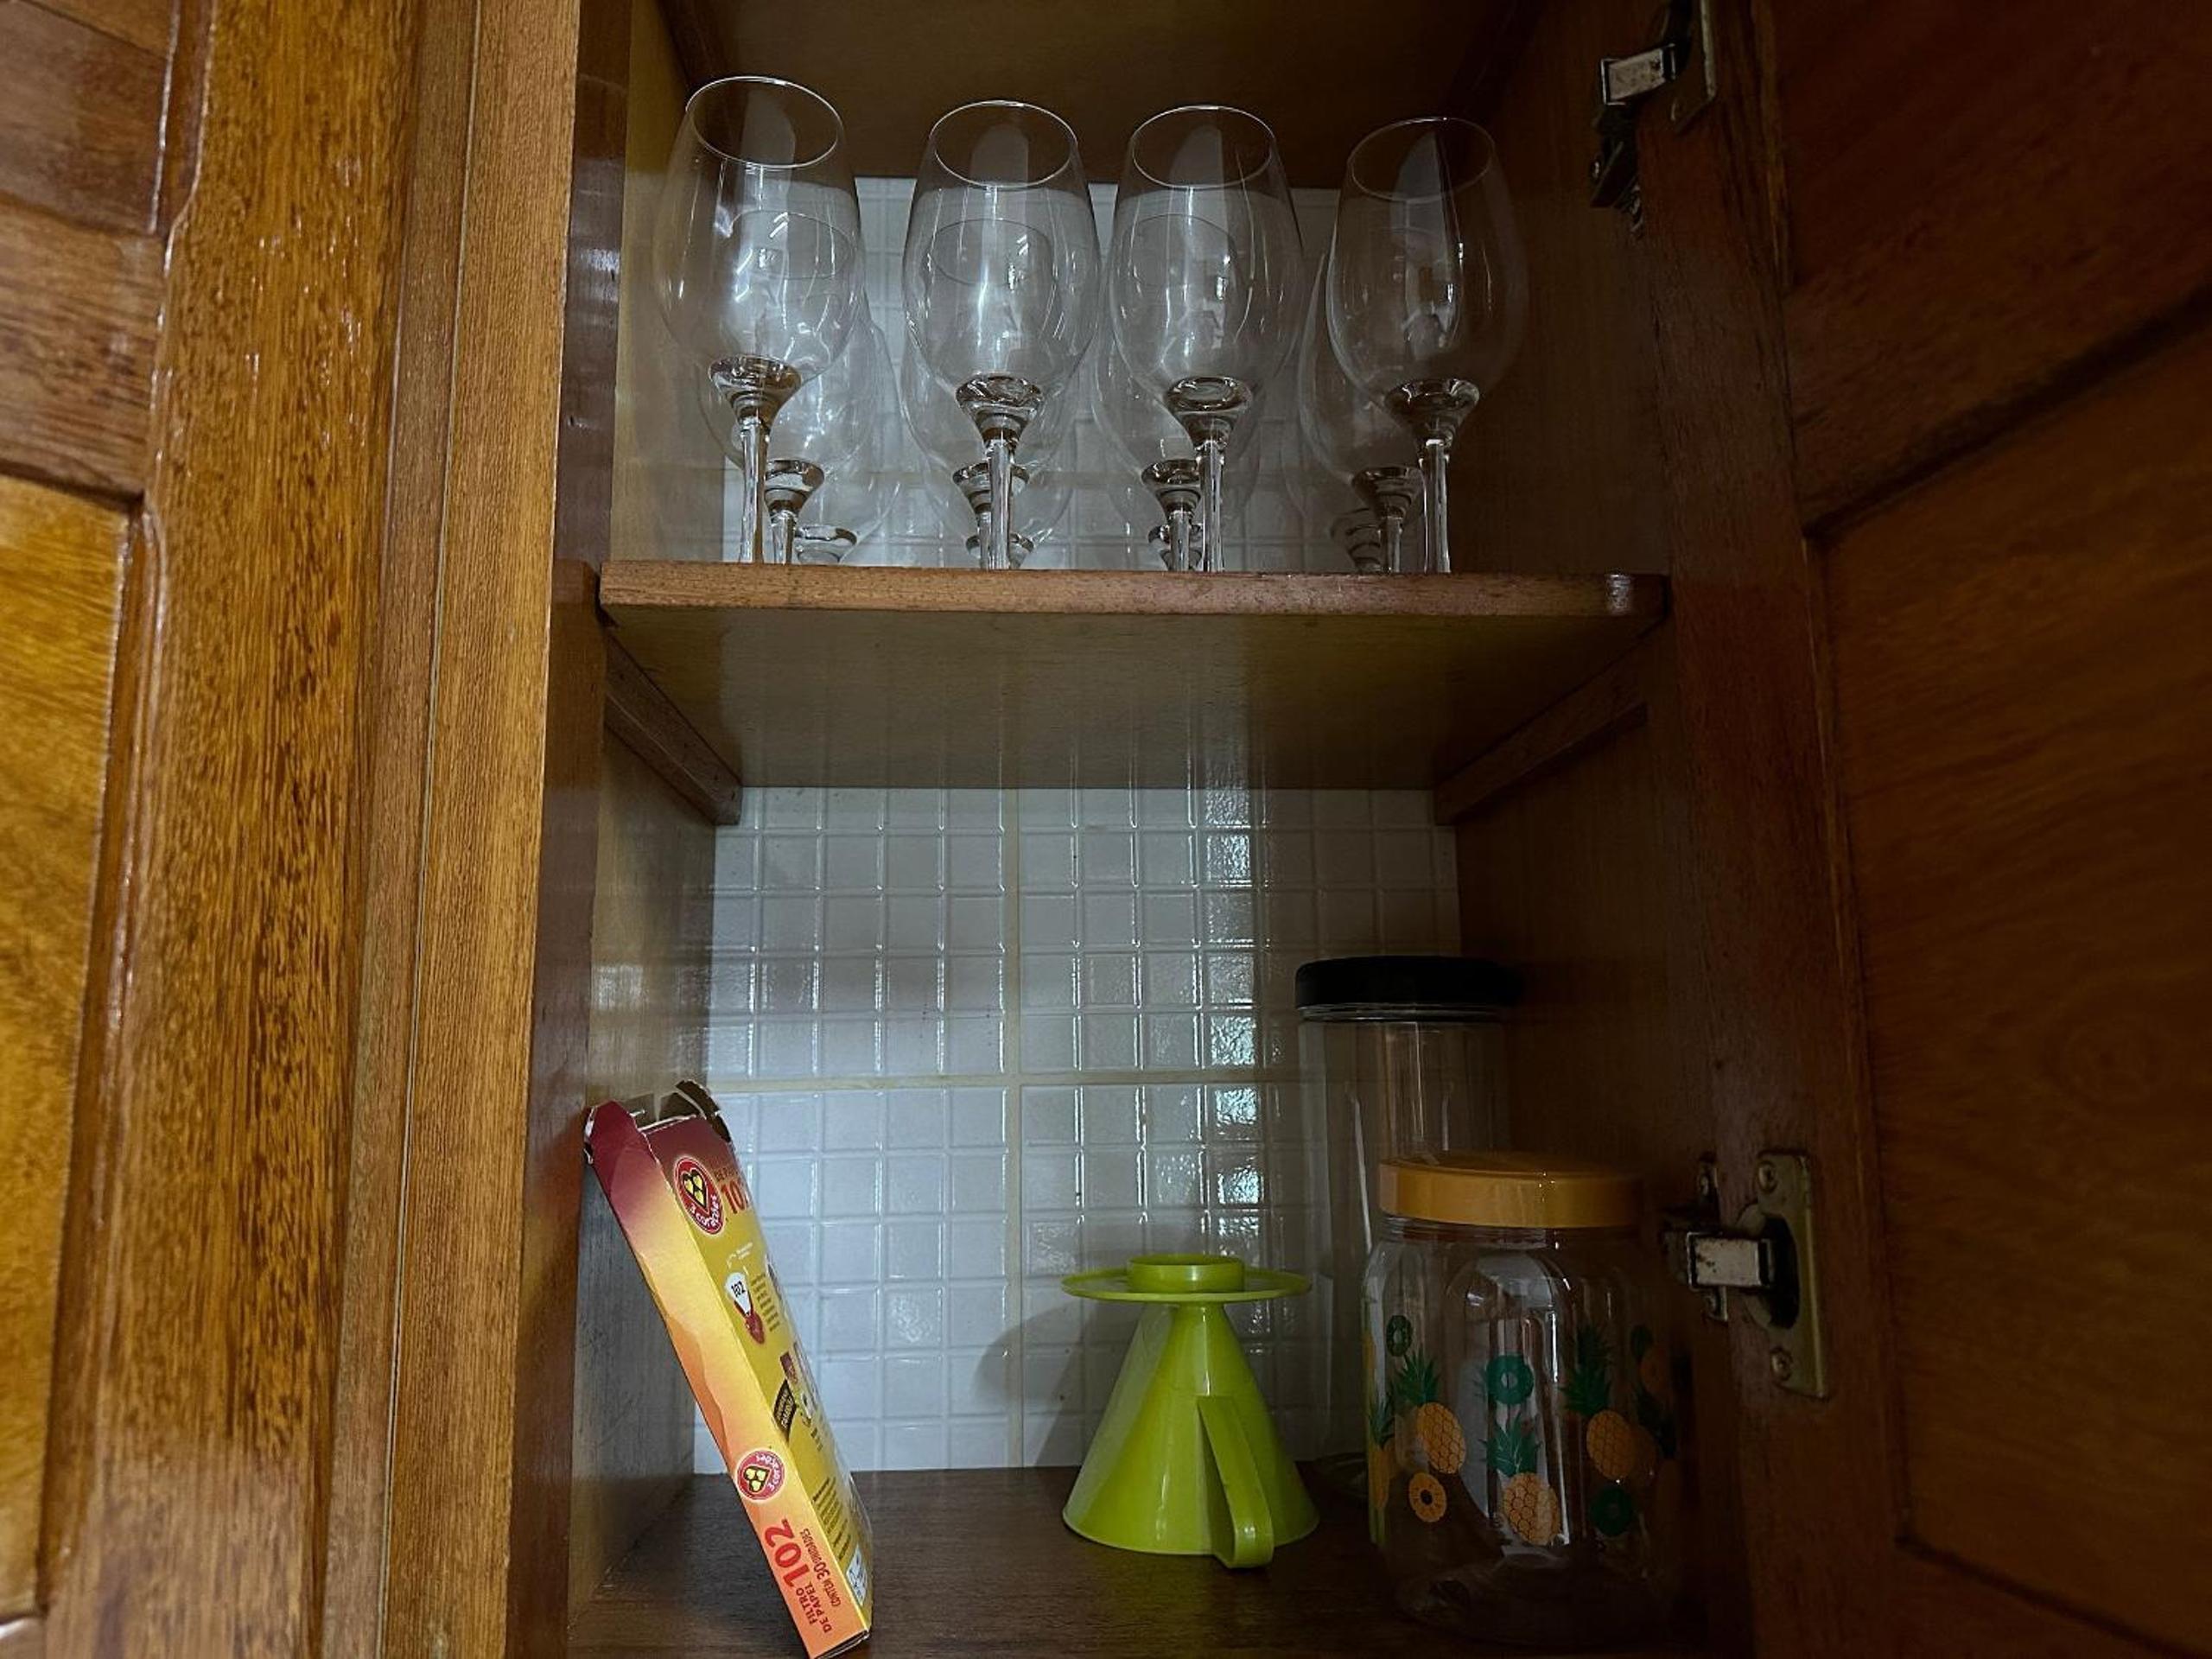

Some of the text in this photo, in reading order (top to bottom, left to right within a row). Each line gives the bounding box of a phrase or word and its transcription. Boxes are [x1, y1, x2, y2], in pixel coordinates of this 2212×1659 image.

[764, 1518, 810, 1587] 102
[813, 1561, 830, 1580] 30
[795, 1587, 817, 1625] FILTRO
[804, 1582, 832, 1633] DE PAPEL
